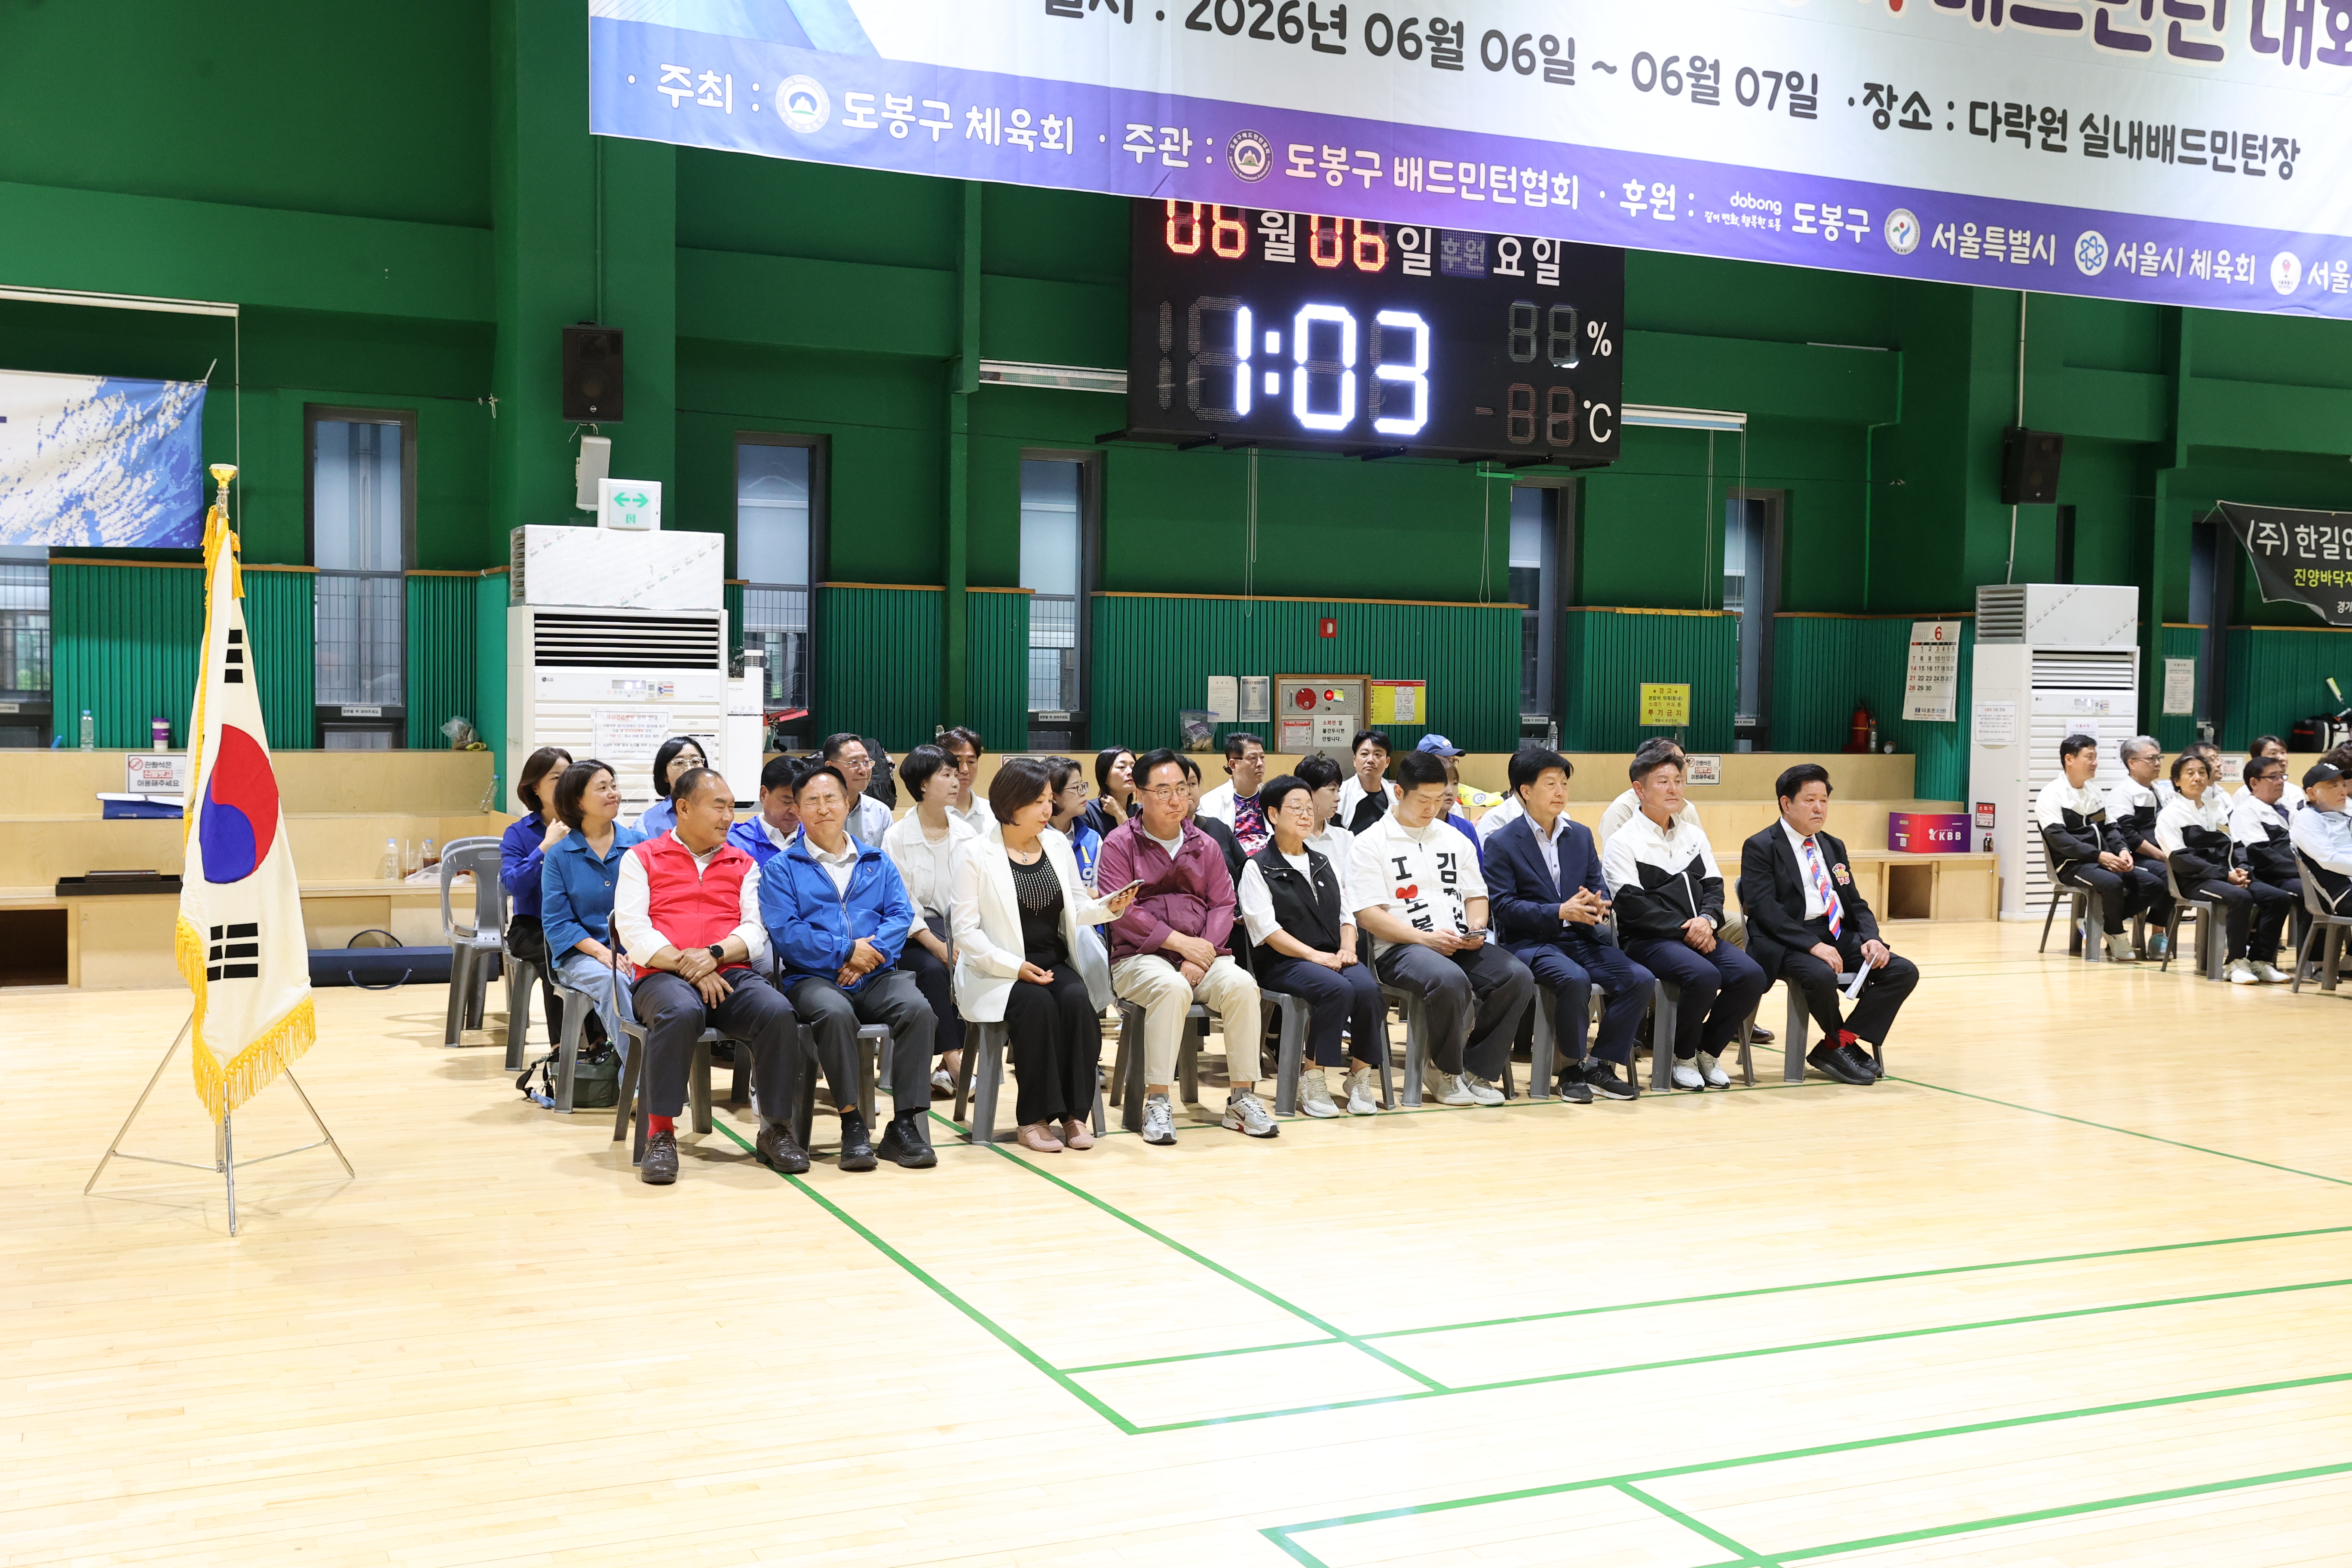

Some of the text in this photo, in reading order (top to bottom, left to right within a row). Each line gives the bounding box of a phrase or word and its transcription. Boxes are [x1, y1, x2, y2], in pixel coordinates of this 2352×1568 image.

[1185, 0, 1347, 55] 2026년
[1364, 11, 1465, 71] 06월
[1480, 29, 1577, 86] 06일
[1631, 50, 1721, 107] 06월
[1735, 67, 1819, 120] 07일
[656, 63, 1074, 155] 주최 도봉구 체육회
[813, 83, 827, 103] Council
[1862, 83, 2300, 181] 장소 다락원 실내배드민턴장
[1122, 123, 1580, 210] 주관 도봉구 배드민턴협회
[1619, 178, 1678, 222] 후원
[1704, 211, 1720, 223] 같이
[1741, 214, 1766, 229] 행복한
[1767, 217, 1781, 232] 도봉
[1730, 191, 1782, 215] dobong
[1167, 199, 1245, 258] 06
[1257, 211, 1295, 263] 월
[1311, 215, 1386, 273] 06
[1396, 227, 1432, 277] 일
[1493, 237, 1561, 285] 요일
[1792, 202, 1871, 244] 도봉구
[1931, 222, 2056, 266] 서울특별시
[2113, 241, 2256, 285] 서울시 체육회
[2307, 260, 2352, 294] 서울
[1234, 303, 1430, 435] 1:03
[2247, 519, 2288, 556] (주)
[1935, 626, 1942, 640] 6
[1939, 832, 1961, 841] KBB
[1391, 856, 1412, 881] I
